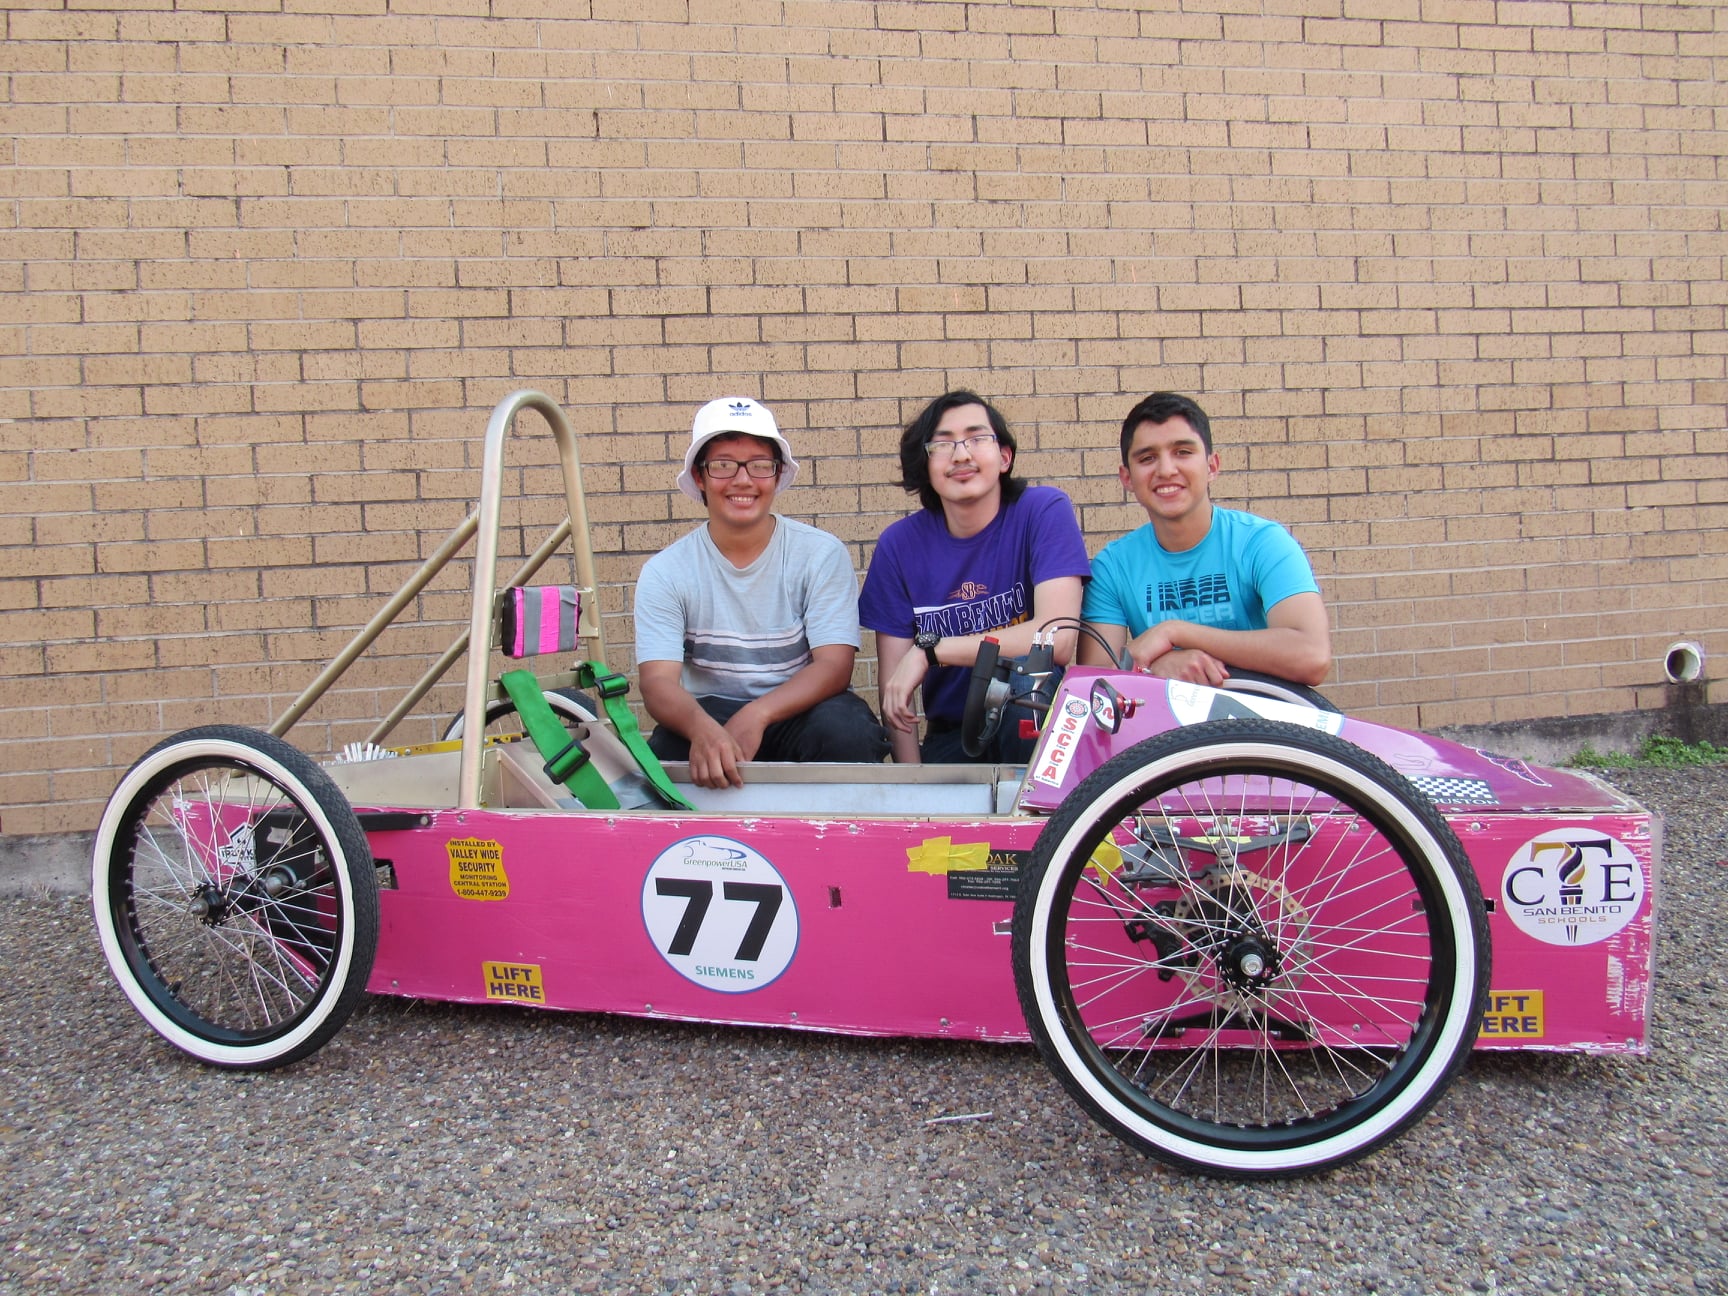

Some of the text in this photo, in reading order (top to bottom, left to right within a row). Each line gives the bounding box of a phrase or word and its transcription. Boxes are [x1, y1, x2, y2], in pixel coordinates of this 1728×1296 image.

[956, 582, 1026, 636] BENITO
[450, 849, 500, 859] VALLEY WIDE
[458, 861, 496, 872] SECURITY
[1523, 905, 1621, 917] SAN BENITO
[655, 877, 783, 962] 77
[1537, 915, 1607, 925] SCHOOLS
[491, 966, 532, 982] LIFT
[695, 965, 755, 979] SIEMENS
[490, 982, 541, 1000] HERE
[1485, 996, 1530, 1013] IFT
[1482, 1016, 1538, 1033] ERE
